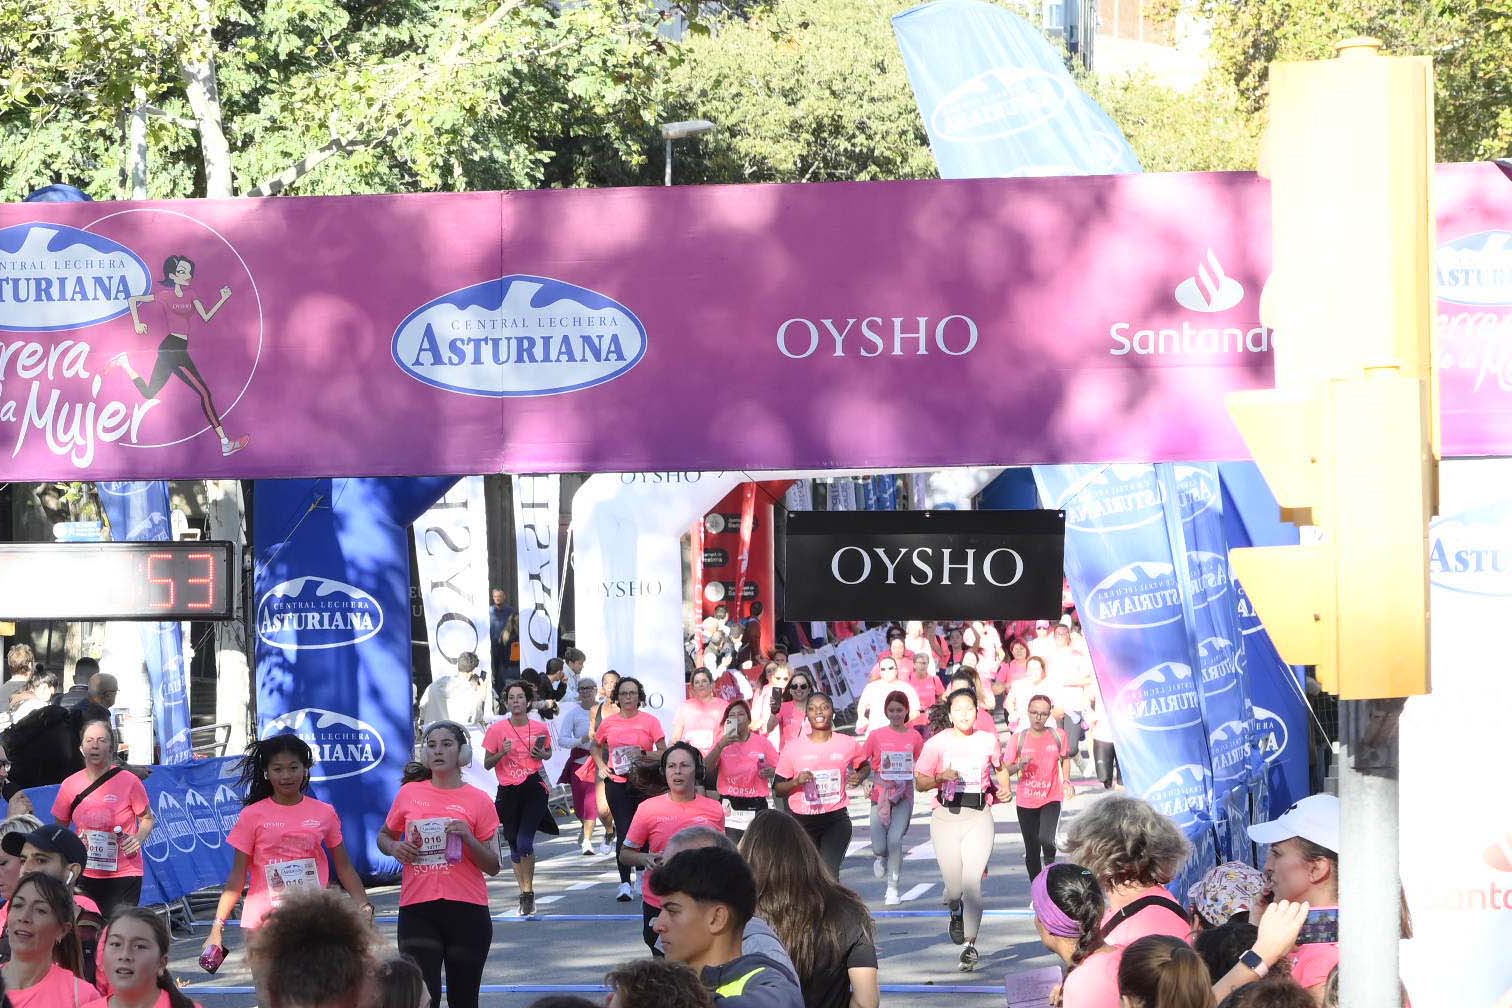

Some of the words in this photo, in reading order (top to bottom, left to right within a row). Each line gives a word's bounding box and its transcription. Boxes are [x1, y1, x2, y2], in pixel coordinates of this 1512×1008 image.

[54, 258, 126, 270] LECHERA
[451, 317, 530, 331] CENTRAL
[537, 315, 620, 329] LECHERA
[411, 321, 628, 367] ASTURIANA
[776, 314, 980, 359] OYSHO
[12, 377, 161, 469] Mujer
[831, 546, 1025, 587] OYSHO
[273, 601, 316, 611] CENTRAL
[320, 600, 370, 611] LECHERA
[260, 605, 375, 634] ASTURIANA
[321, 732, 371, 741] LECHERA
[309, 743, 376, 762] RIANA
